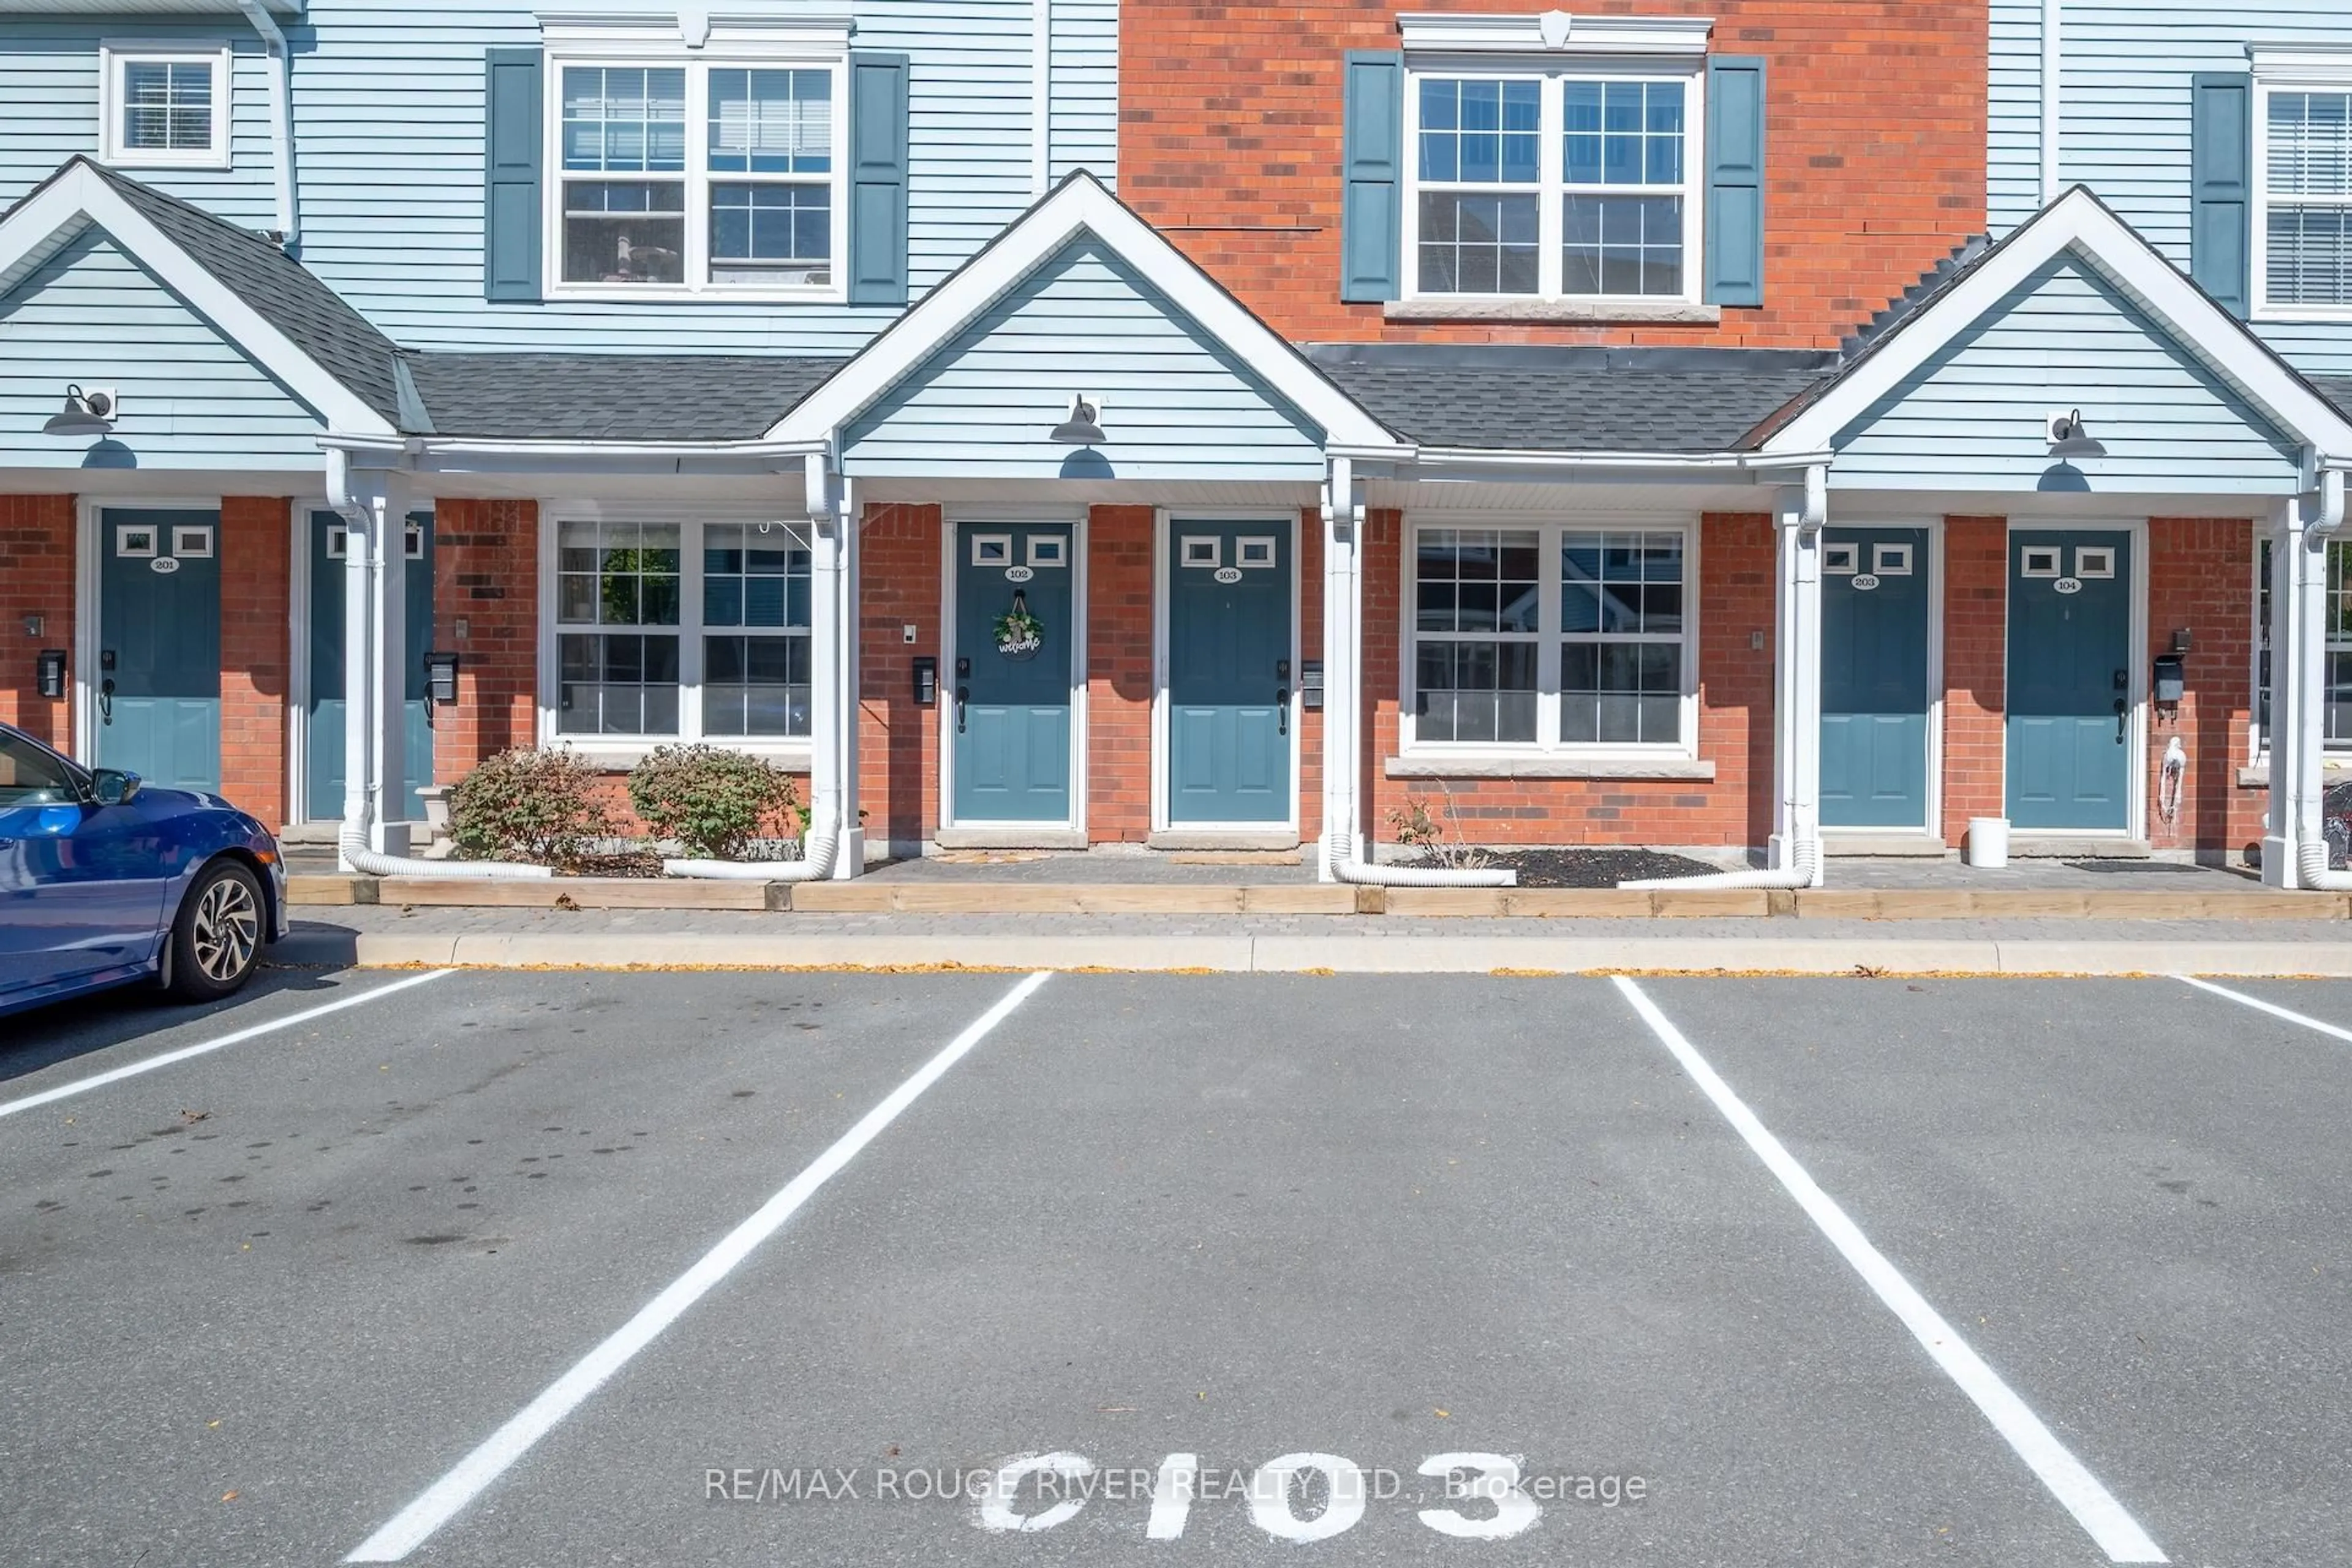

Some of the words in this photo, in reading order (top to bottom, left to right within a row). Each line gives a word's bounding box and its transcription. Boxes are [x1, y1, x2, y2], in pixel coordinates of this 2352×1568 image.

[1011, 570, 1028, 578] 102
[1219, 571, 1237, 579] 103
[976, 1451, 1540, 1540] C103
